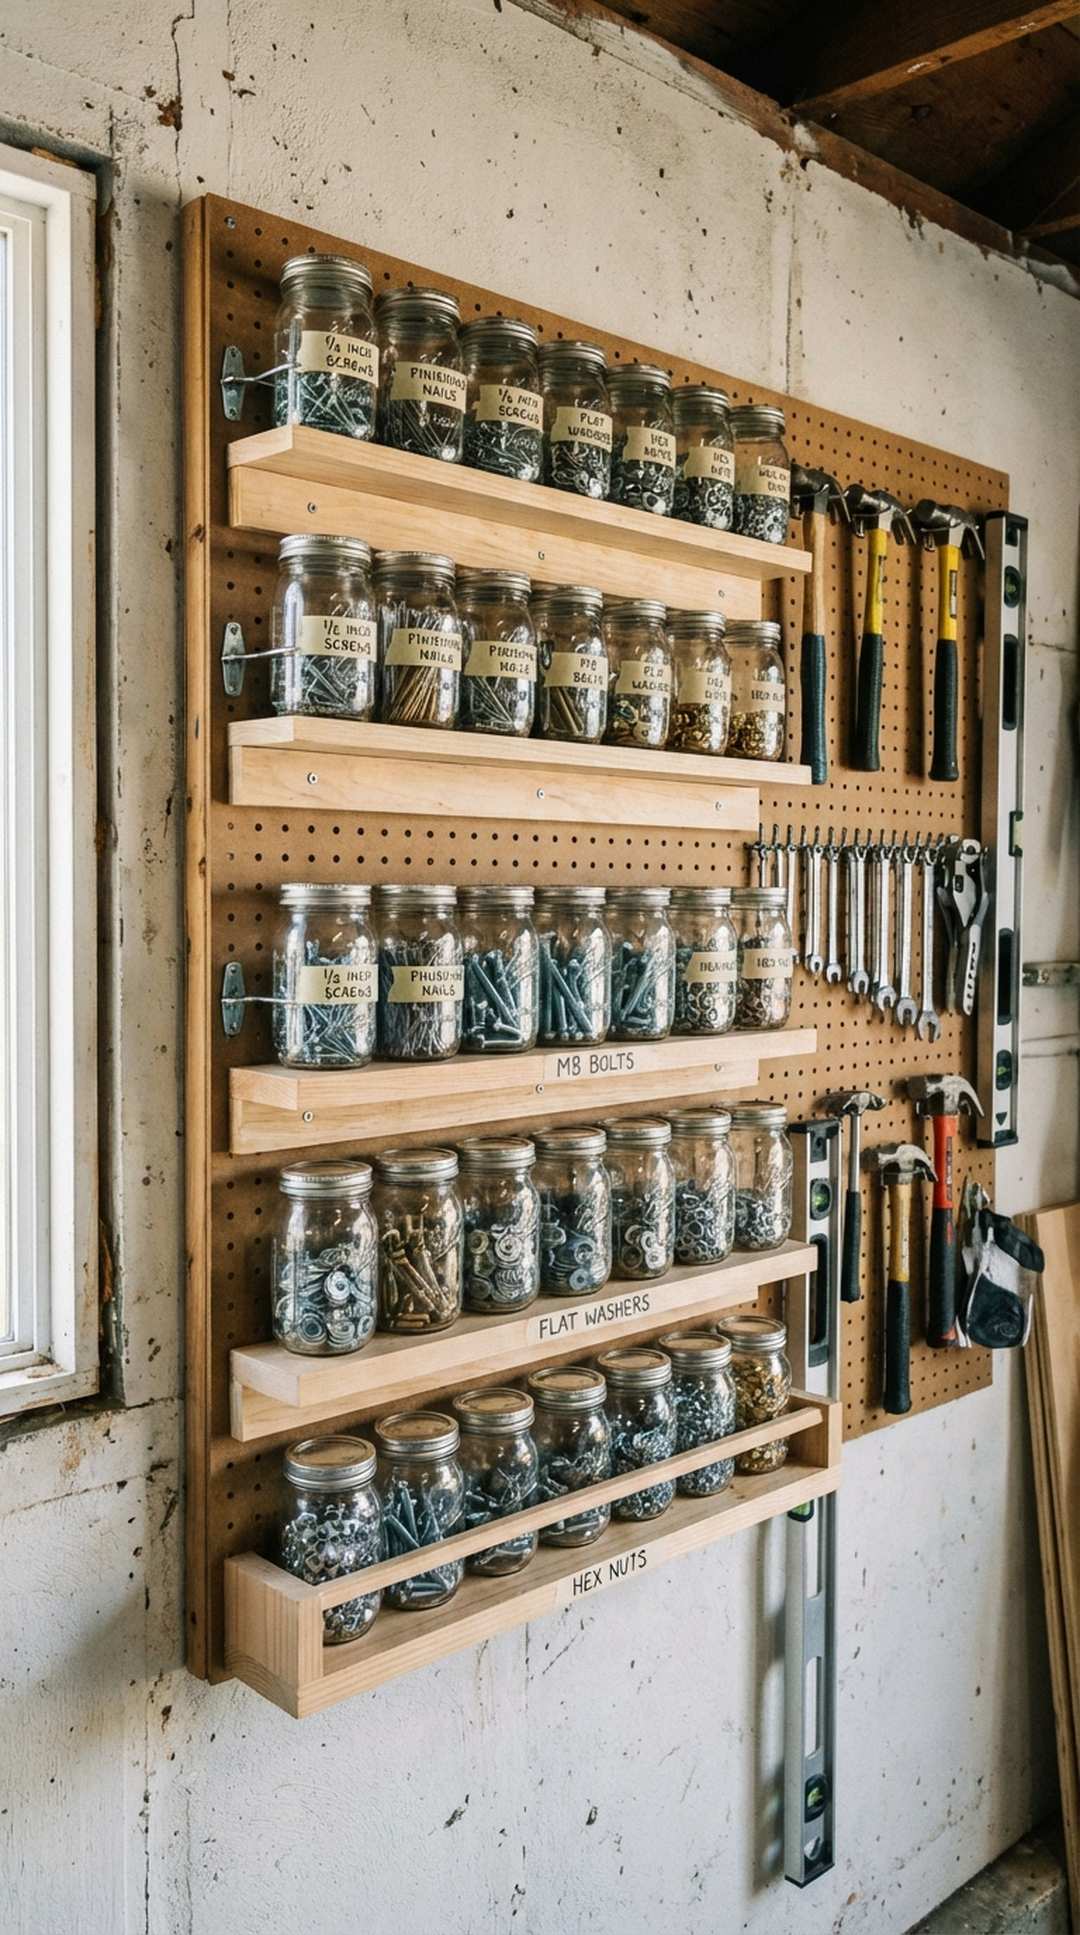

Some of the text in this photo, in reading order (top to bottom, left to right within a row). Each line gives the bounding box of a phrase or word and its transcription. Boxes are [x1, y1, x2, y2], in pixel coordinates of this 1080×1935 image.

[557, 1052, 634, 1077] M8 BOLTS
[539, 1294, 650, 1339] FLAT WASHERS
[573, 1549, 647, 1596] HEX NUTS
